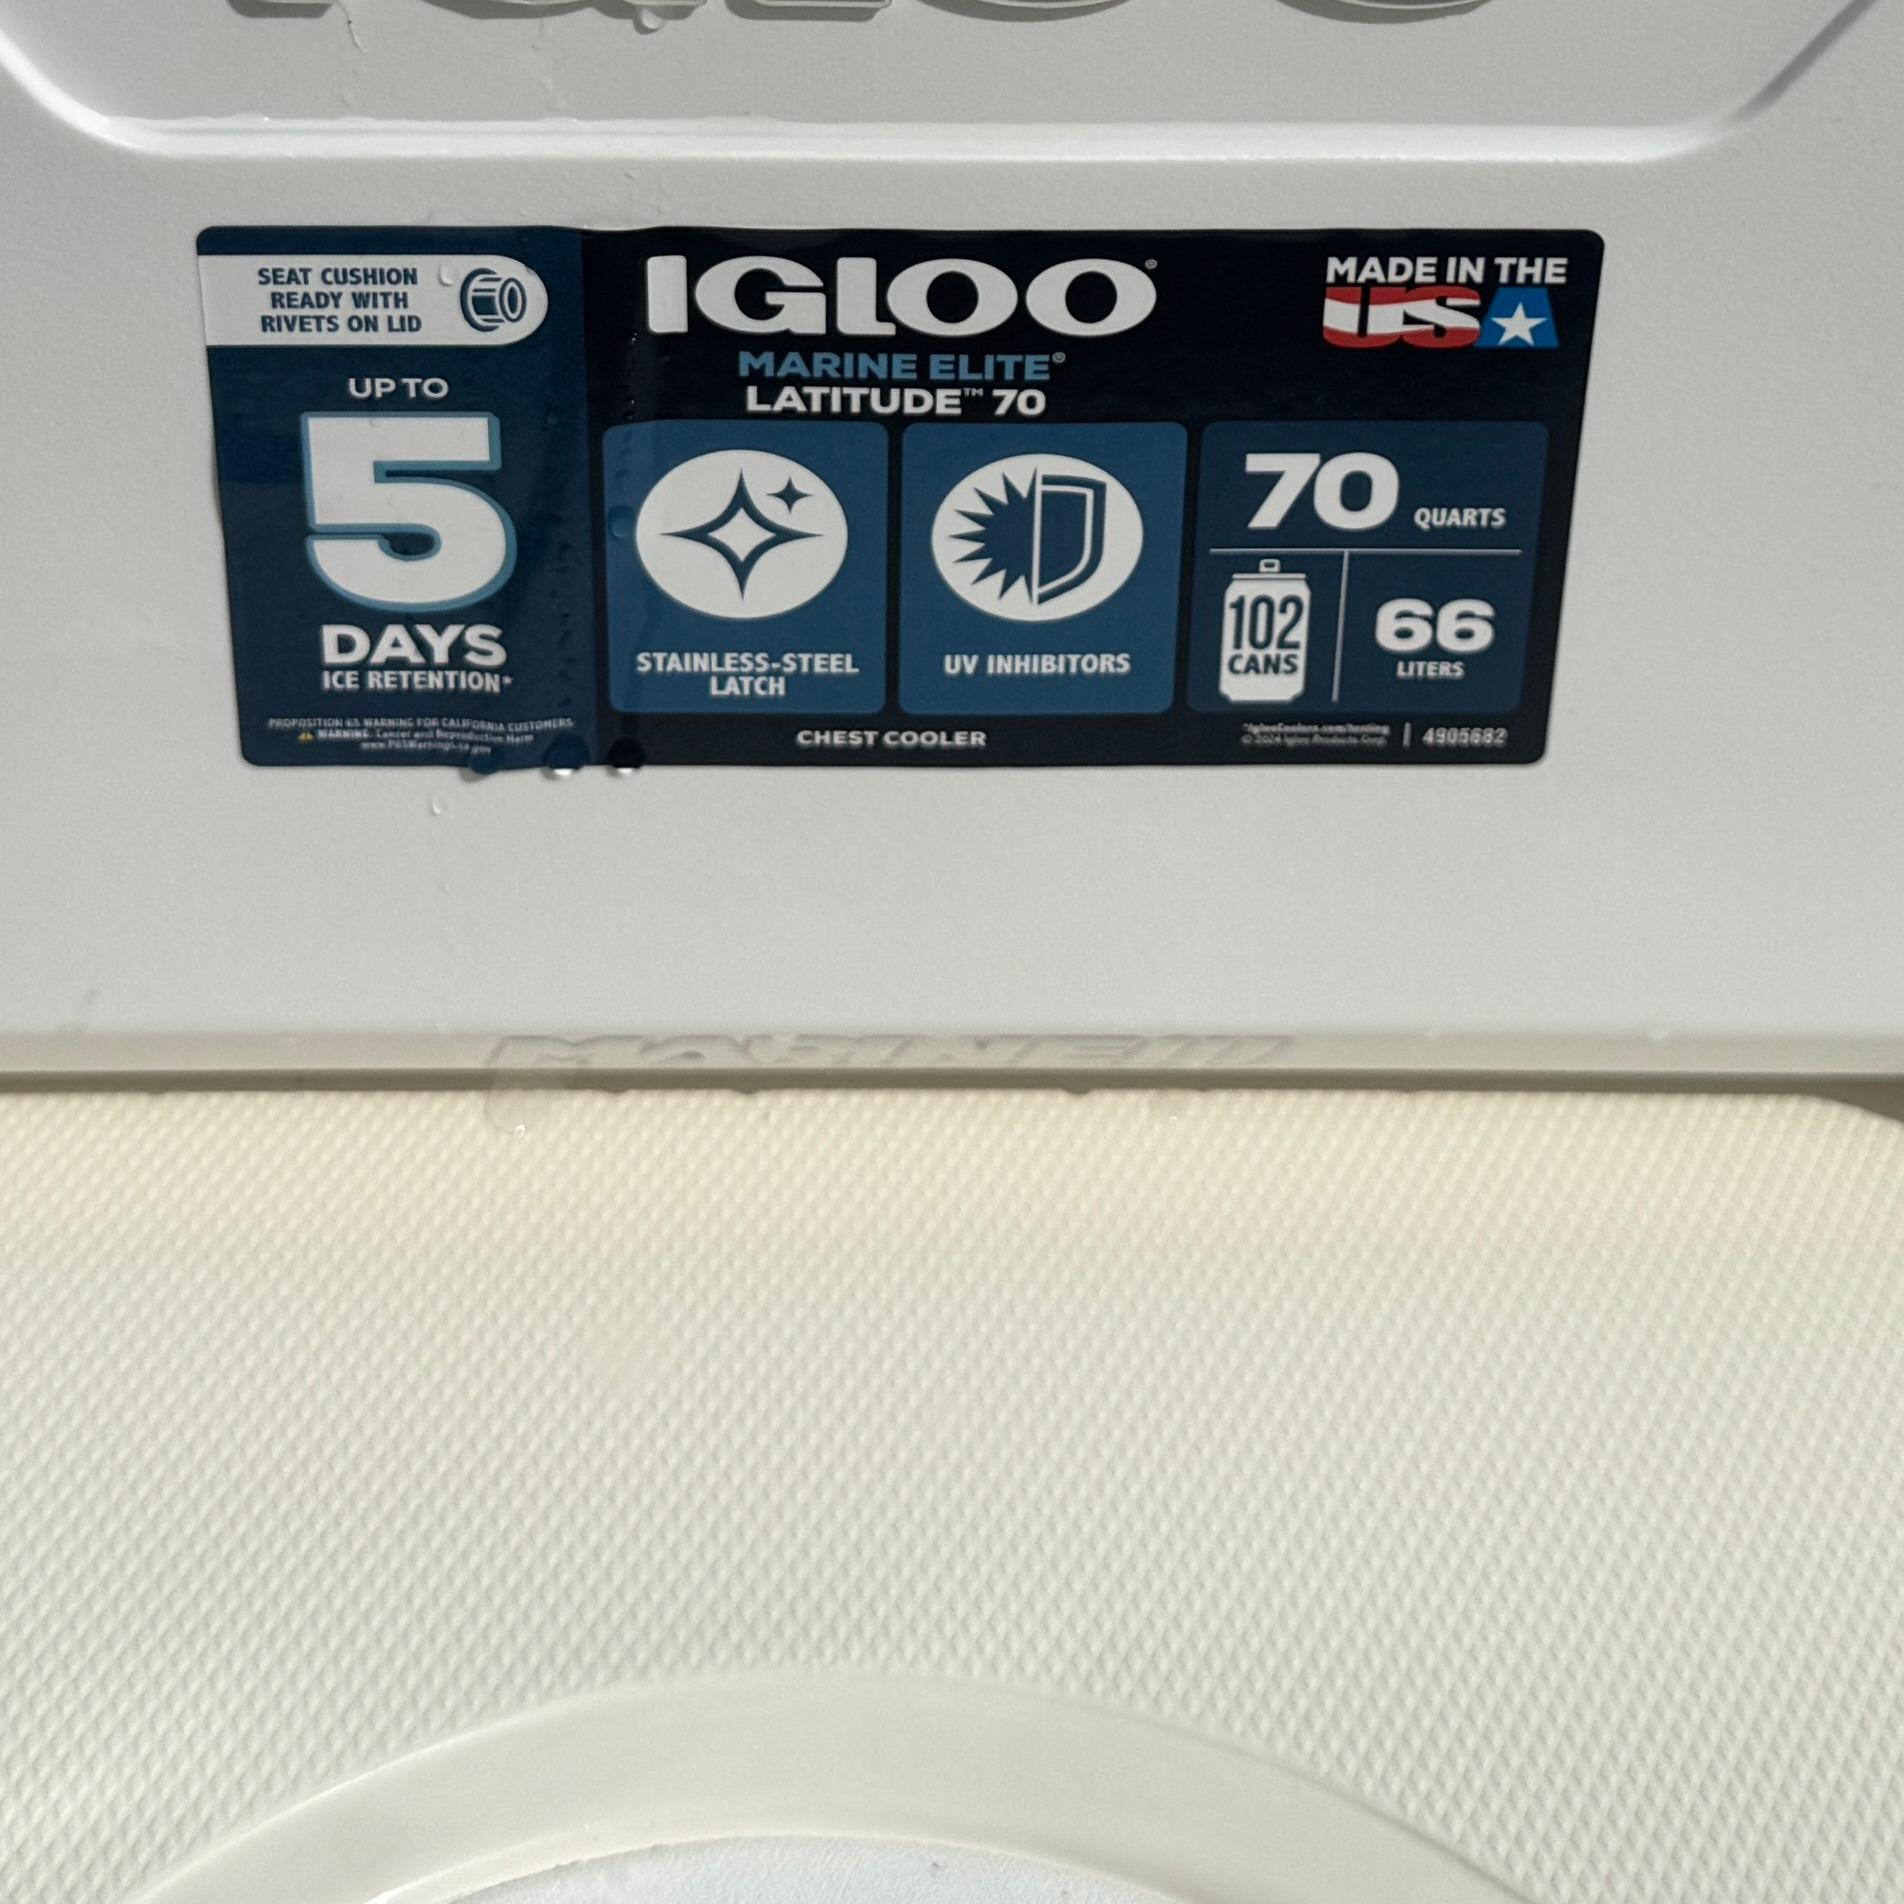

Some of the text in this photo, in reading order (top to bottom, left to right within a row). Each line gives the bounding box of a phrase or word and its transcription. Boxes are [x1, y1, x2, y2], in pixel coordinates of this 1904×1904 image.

[257, 267, 418, 286] SEAT CUSHION
[1326, 256, 1568, 284] MADE IN THE
[270, 291, 409, 309] READY WITH
[260, 314, 422, 333] RIVETS ON LID
[1322, 286, 1560, 349] USA
[738, 350, 918, 380] MARINE
[348, 377, 449, 399] UP TO
[992, 388, 1046, 416] 70
[1245, 452, 1506, 530] 70 QUARTS
[301, 412, 517, 612] 5
[1228, 595, 1301, 651] 102
[1375, 598, 1494, 653] 66
[321, 624, 507, 667] DAYS
[636, 652, 860, 674] STAINLESS-STEEL
[944, 653, 1131, 675] UV INHIBITORS
[1227, 653, 1298, 675] CANS
[1396, 660, 1464, 679] LITERS
[322, 670, 360, 690] ICE
[710, 671, 786, 696] LATCH
[362, 717, 414, 728] WARNING
[416, 717, 439, 728] FOR
[441, 717, 505, 732] CALIFORNIA
[507, 717, 574, 733] CUSTOMERS
[796, 730, 987, 747] CHEST COOLER
